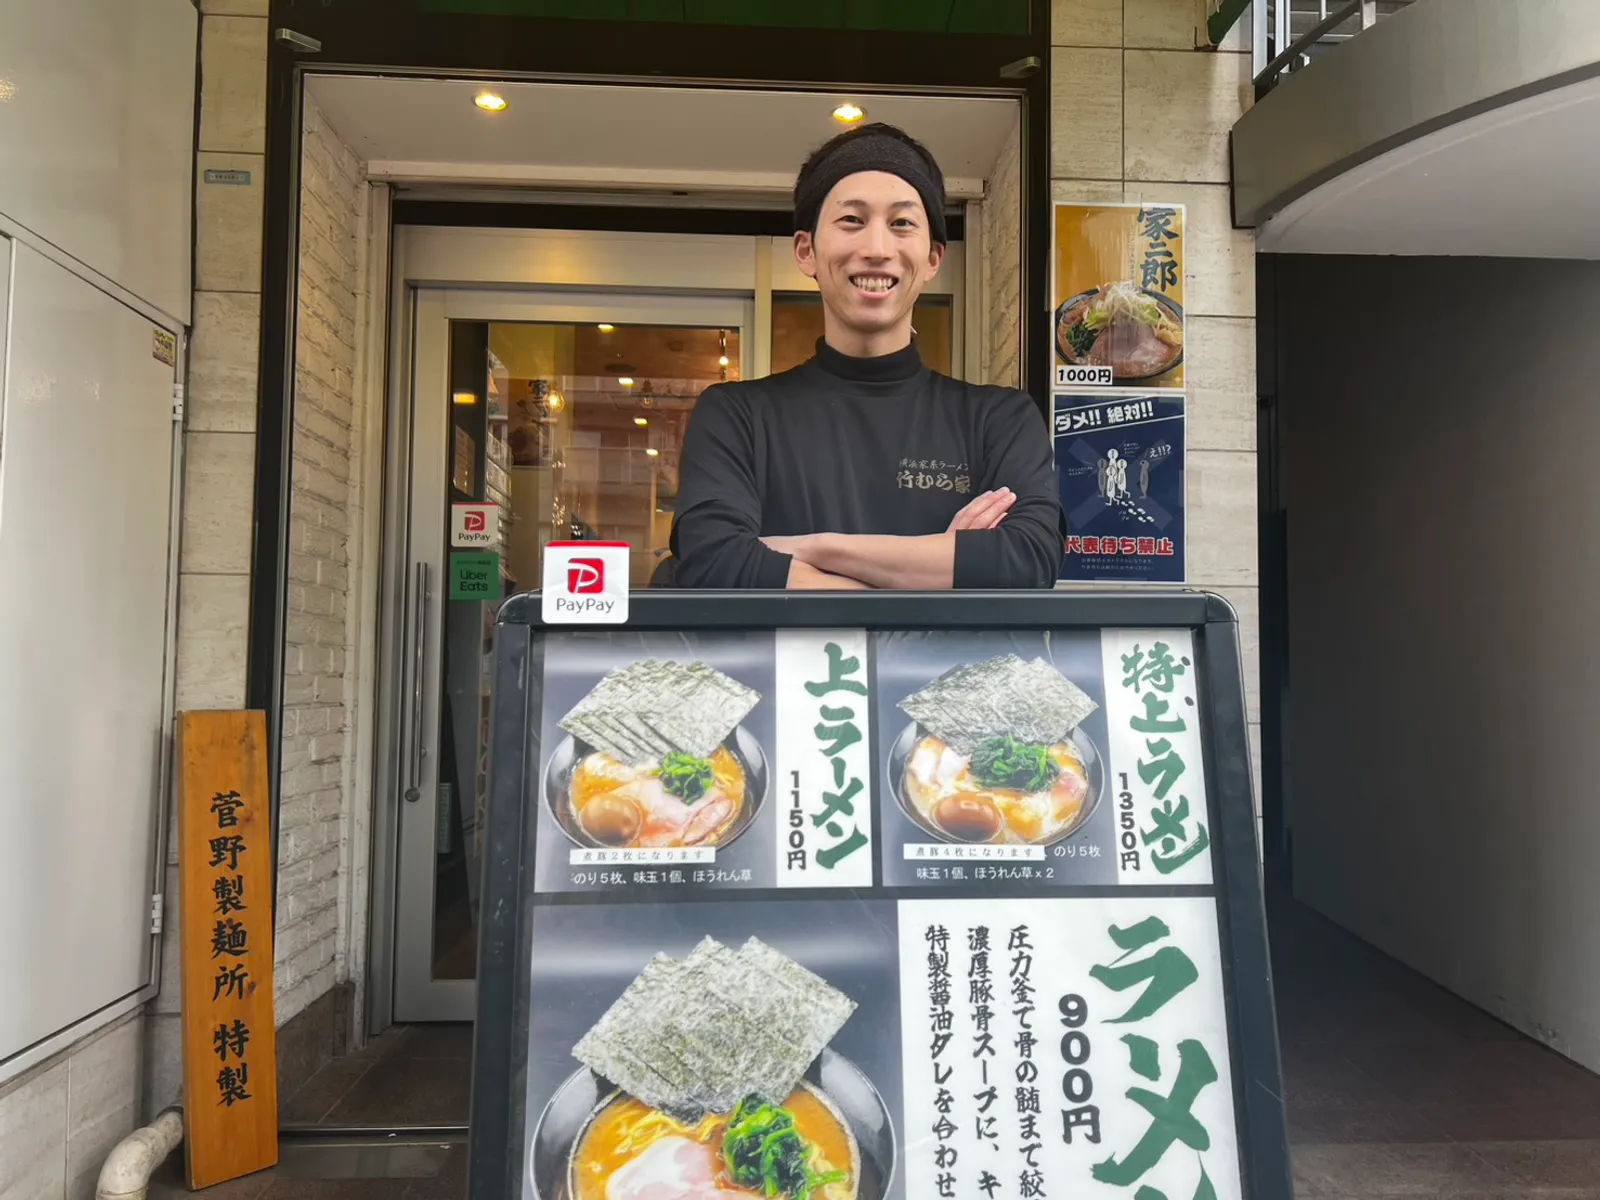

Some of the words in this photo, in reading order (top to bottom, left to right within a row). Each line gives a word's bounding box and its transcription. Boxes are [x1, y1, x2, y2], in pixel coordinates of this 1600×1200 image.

[1137, 207, 1180, 292] 家二郎
[1058, 369, 1112, 383] 1000円
[458, 533, 491, 541] PayPay
[460, 569, 488, 580] Uber
[1065, 535, 1174, 555] 代表待ち禁止
[460, 581, 488, 591] Eats
[556, 598, 615, 613] PayPay
[804, 642, 868, 870] 上ラーメン
[1120, 641, 1209, 875] 特上ラーメン
[787, 771, 807, 870] 1150円
[1118, 772, 1140, 872] 1350円
[213, 1019, 253, 1107] 特製
[1058, 993, 1102, 1145] 900円
